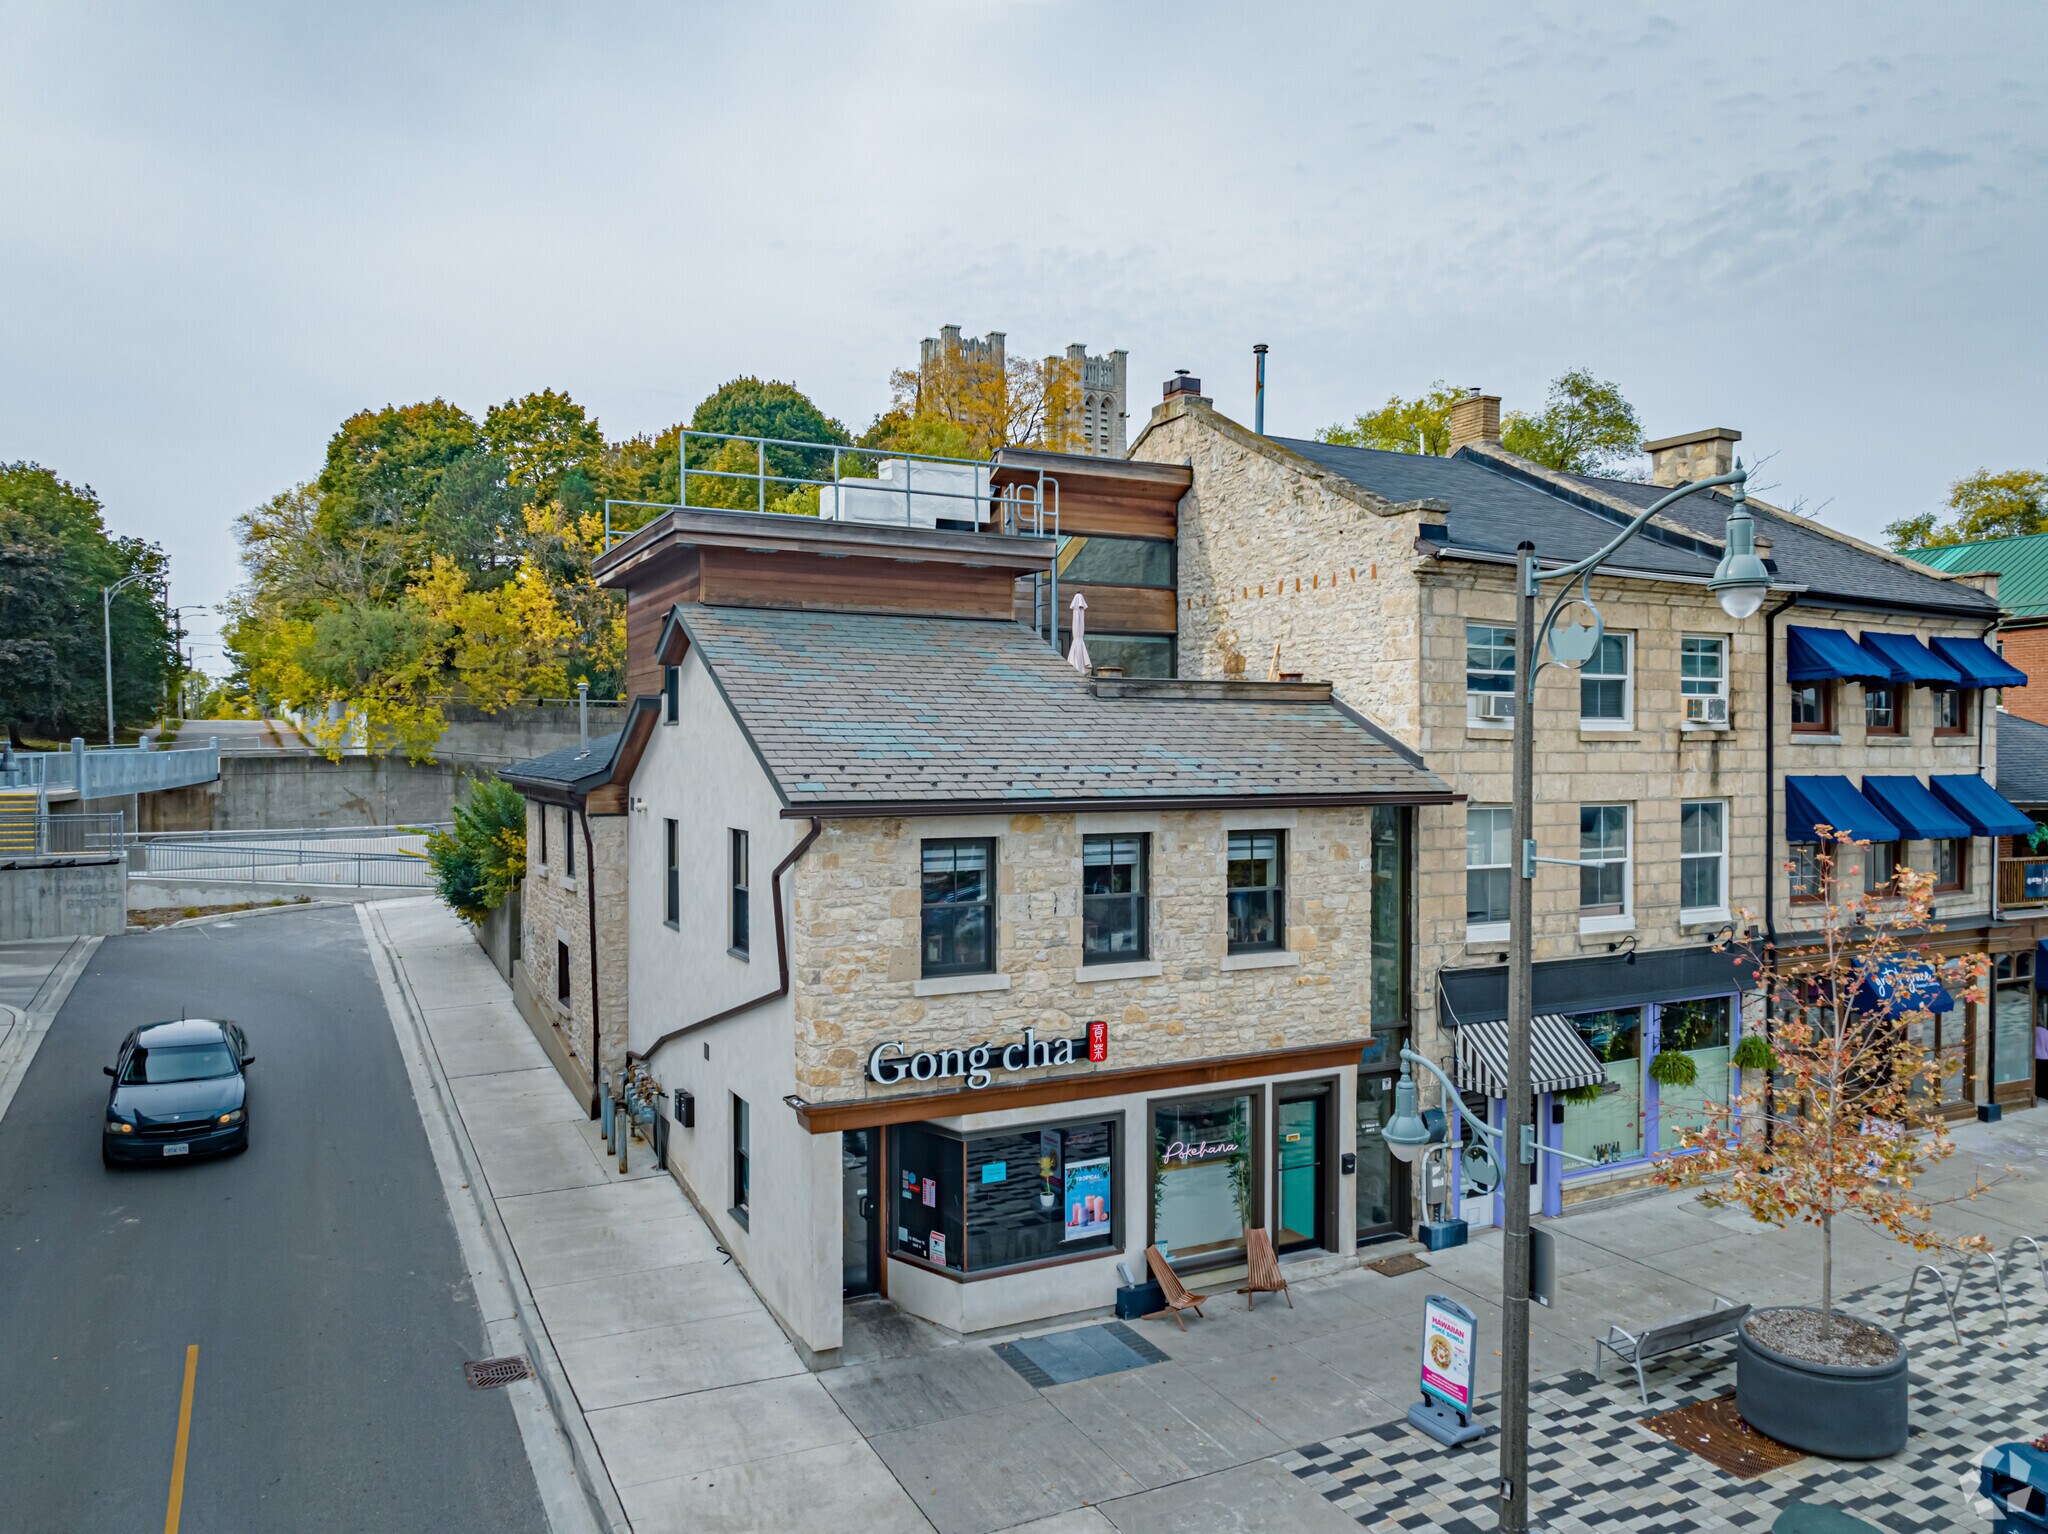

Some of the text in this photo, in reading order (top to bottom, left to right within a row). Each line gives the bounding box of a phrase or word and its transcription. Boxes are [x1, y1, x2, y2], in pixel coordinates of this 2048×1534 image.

[869, 1027, 1076, 1090] Gong cha
[1075, 1174, 1100, 1182] TROPICAL
[1432, 1316, 1465, 1338] HAWAIIAN
